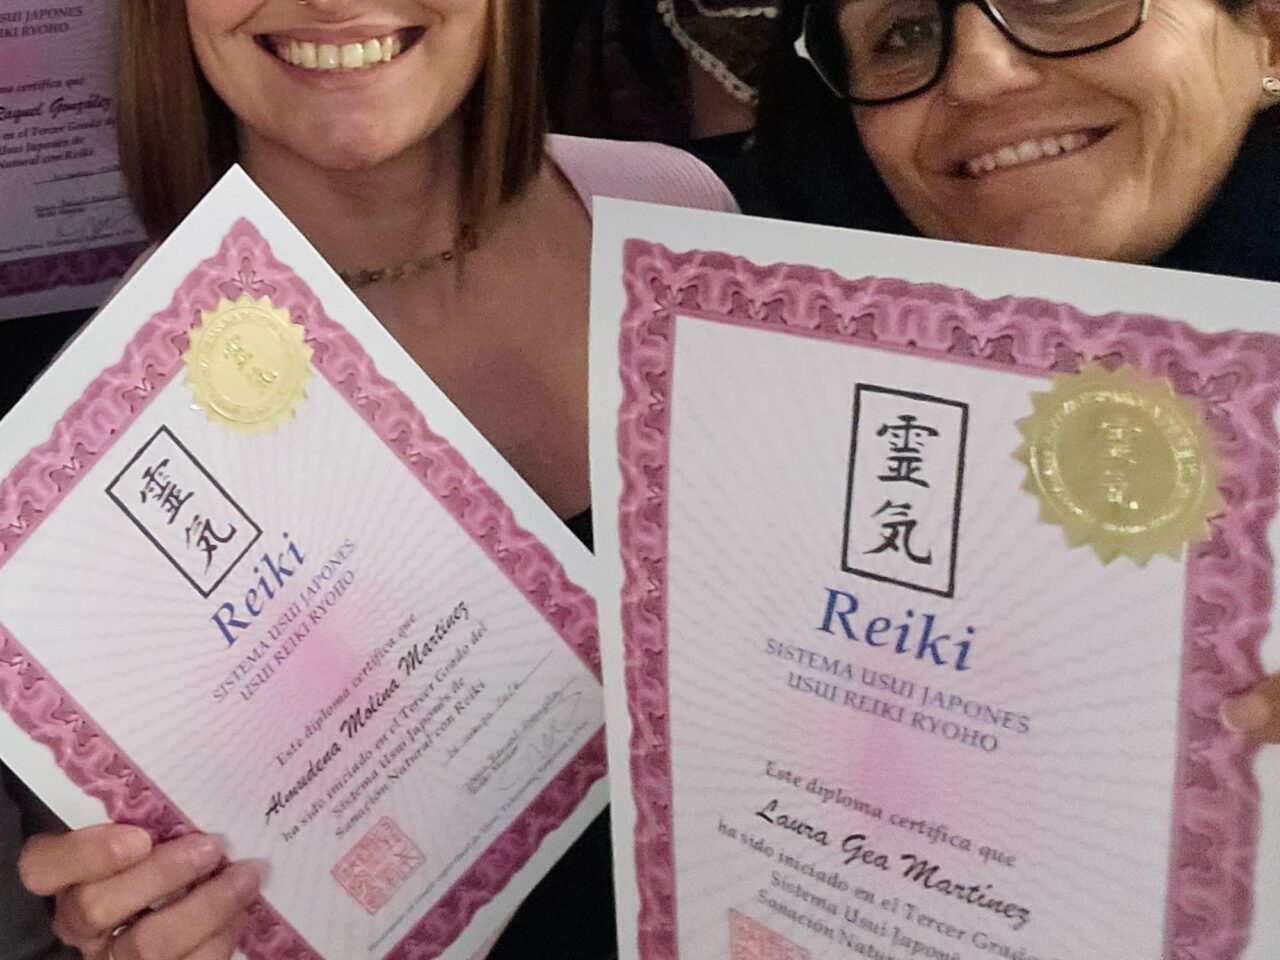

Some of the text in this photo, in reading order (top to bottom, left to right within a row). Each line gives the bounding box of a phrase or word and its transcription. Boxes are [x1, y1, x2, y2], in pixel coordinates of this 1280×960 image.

[24, 6, 83, 23] JAPONES
[210, 532, 305, 649] Reiki
[213, 539, 355, 703] SISTEMA USUI JAPONES
[816, 587, 976, 672] Reiki
[240, 570, 355, 701] USUI REIKI RYOHO
[276, 738, 303, 767] Este
[305, 688, 351, 739] diploma
[339, 678, 400, 739] Molina
[764, 638, 1030, 734] SISTEMA USUI JAPONES
[787, 671, 998, 752] USUI REIKI RYOHO
[755, 799, 829, 846] Laura
[841, 834, 891, 870] Gea
[764, 760, 1017, 868] Este diploma certifica que
[718, 818, 737, 839] ha
[740, 832, 775, 857] sido
[854, 888, 875, 904] en
[904, 902, 968, 940] Tercer
[971, 931, 1038, 959] Grad
[844, 906, 888, 937] Usui
